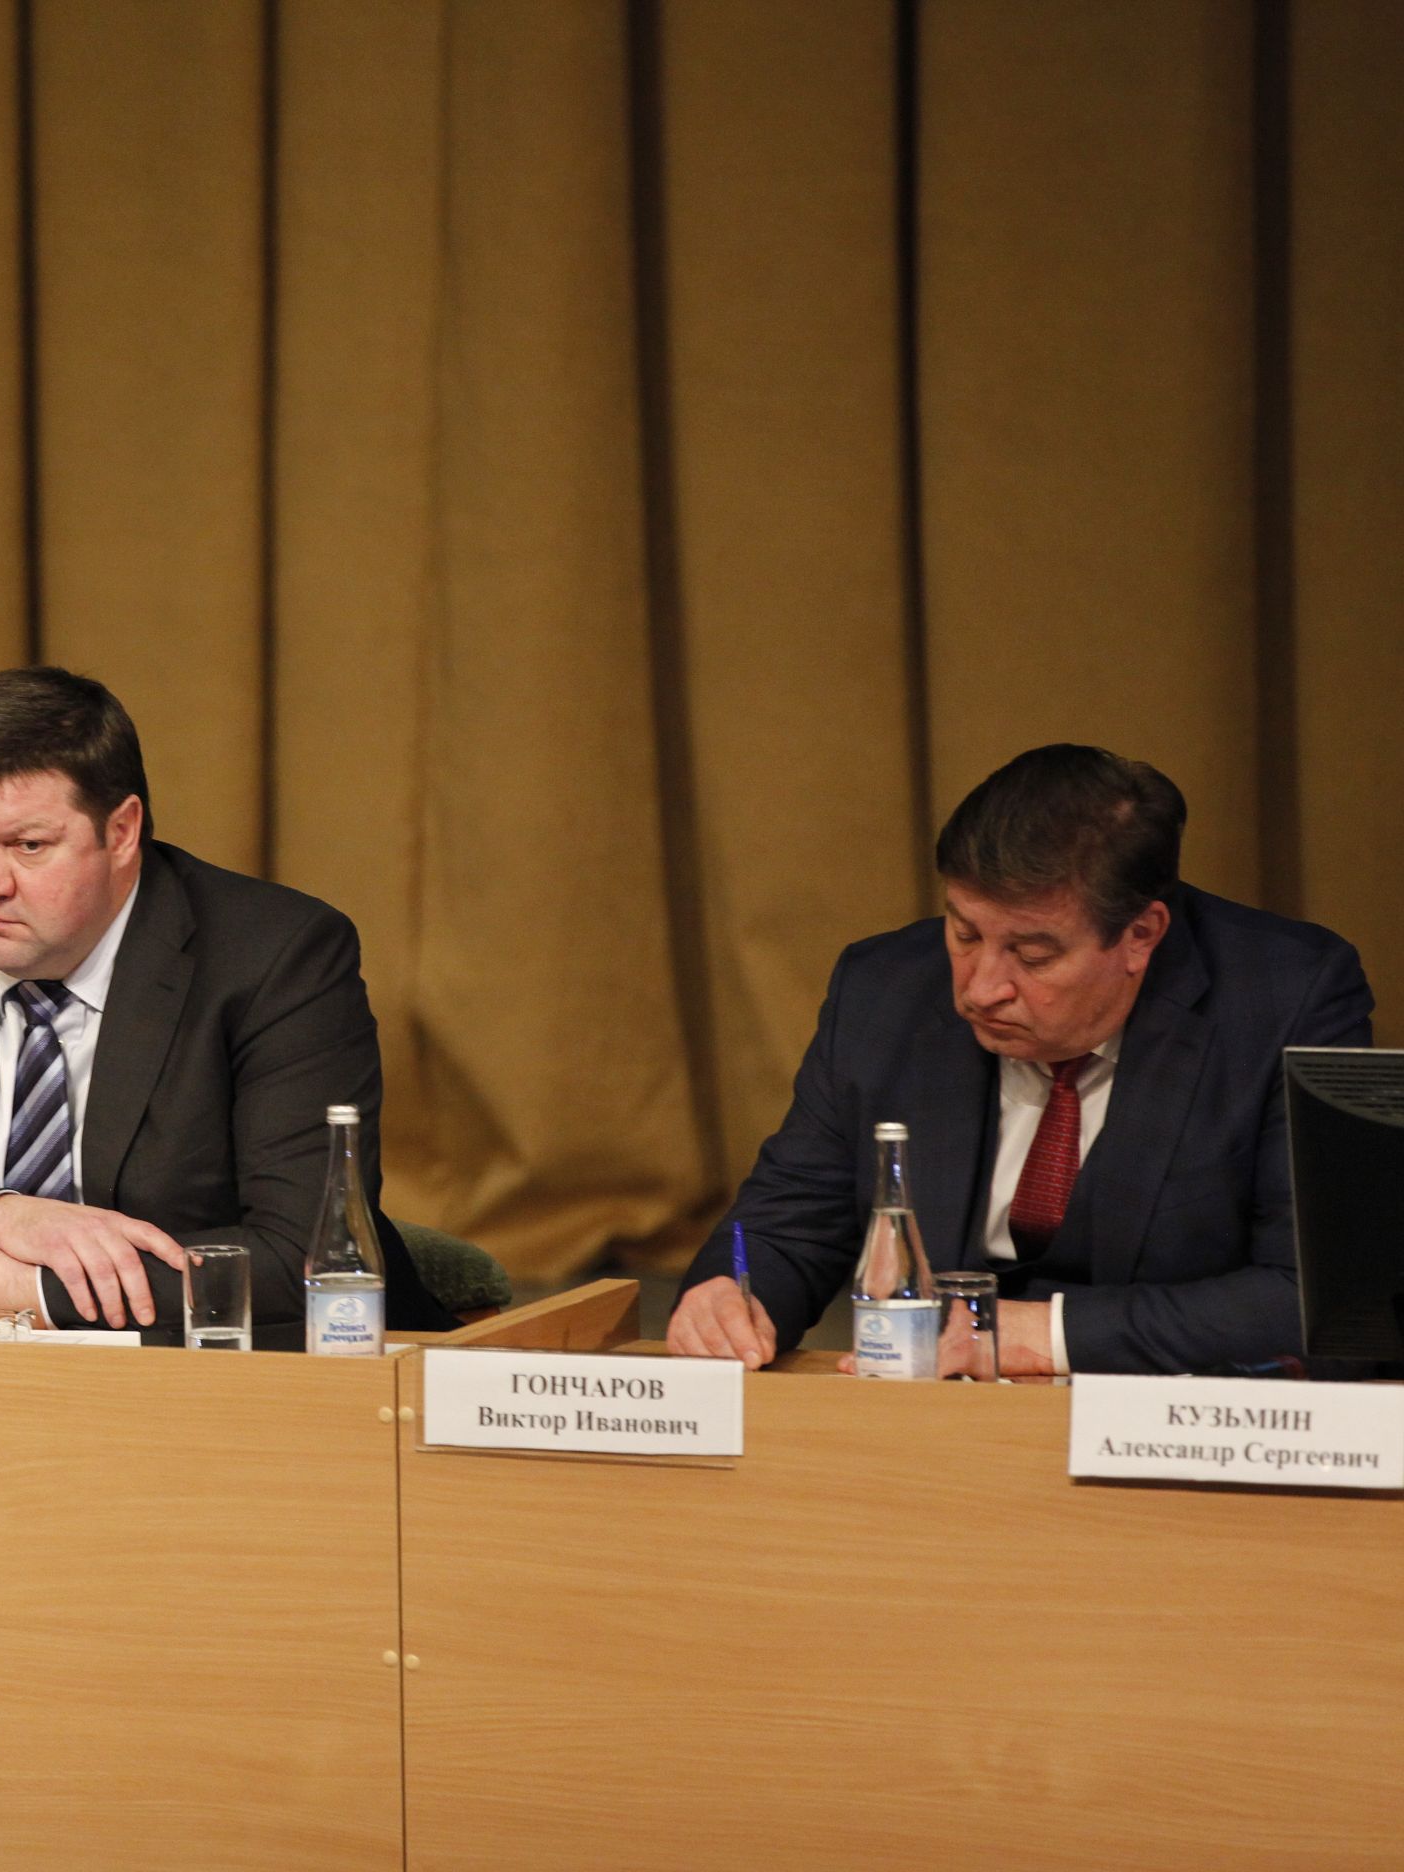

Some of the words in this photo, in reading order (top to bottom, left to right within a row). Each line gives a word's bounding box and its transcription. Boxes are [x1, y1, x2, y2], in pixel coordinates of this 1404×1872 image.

[511, 1373, 665, 1400] ГОНЧАРОВ
[478, 1406, 567, 1435] Виктор
[575, 1410, 700, 1436] Иванович
[1167, 1403, 1313, 1431] КУЗЬМИН
[1097, 1436, 1235, 1466] Александр
[1244, 1441, 1380, 1470] Сергеевич
